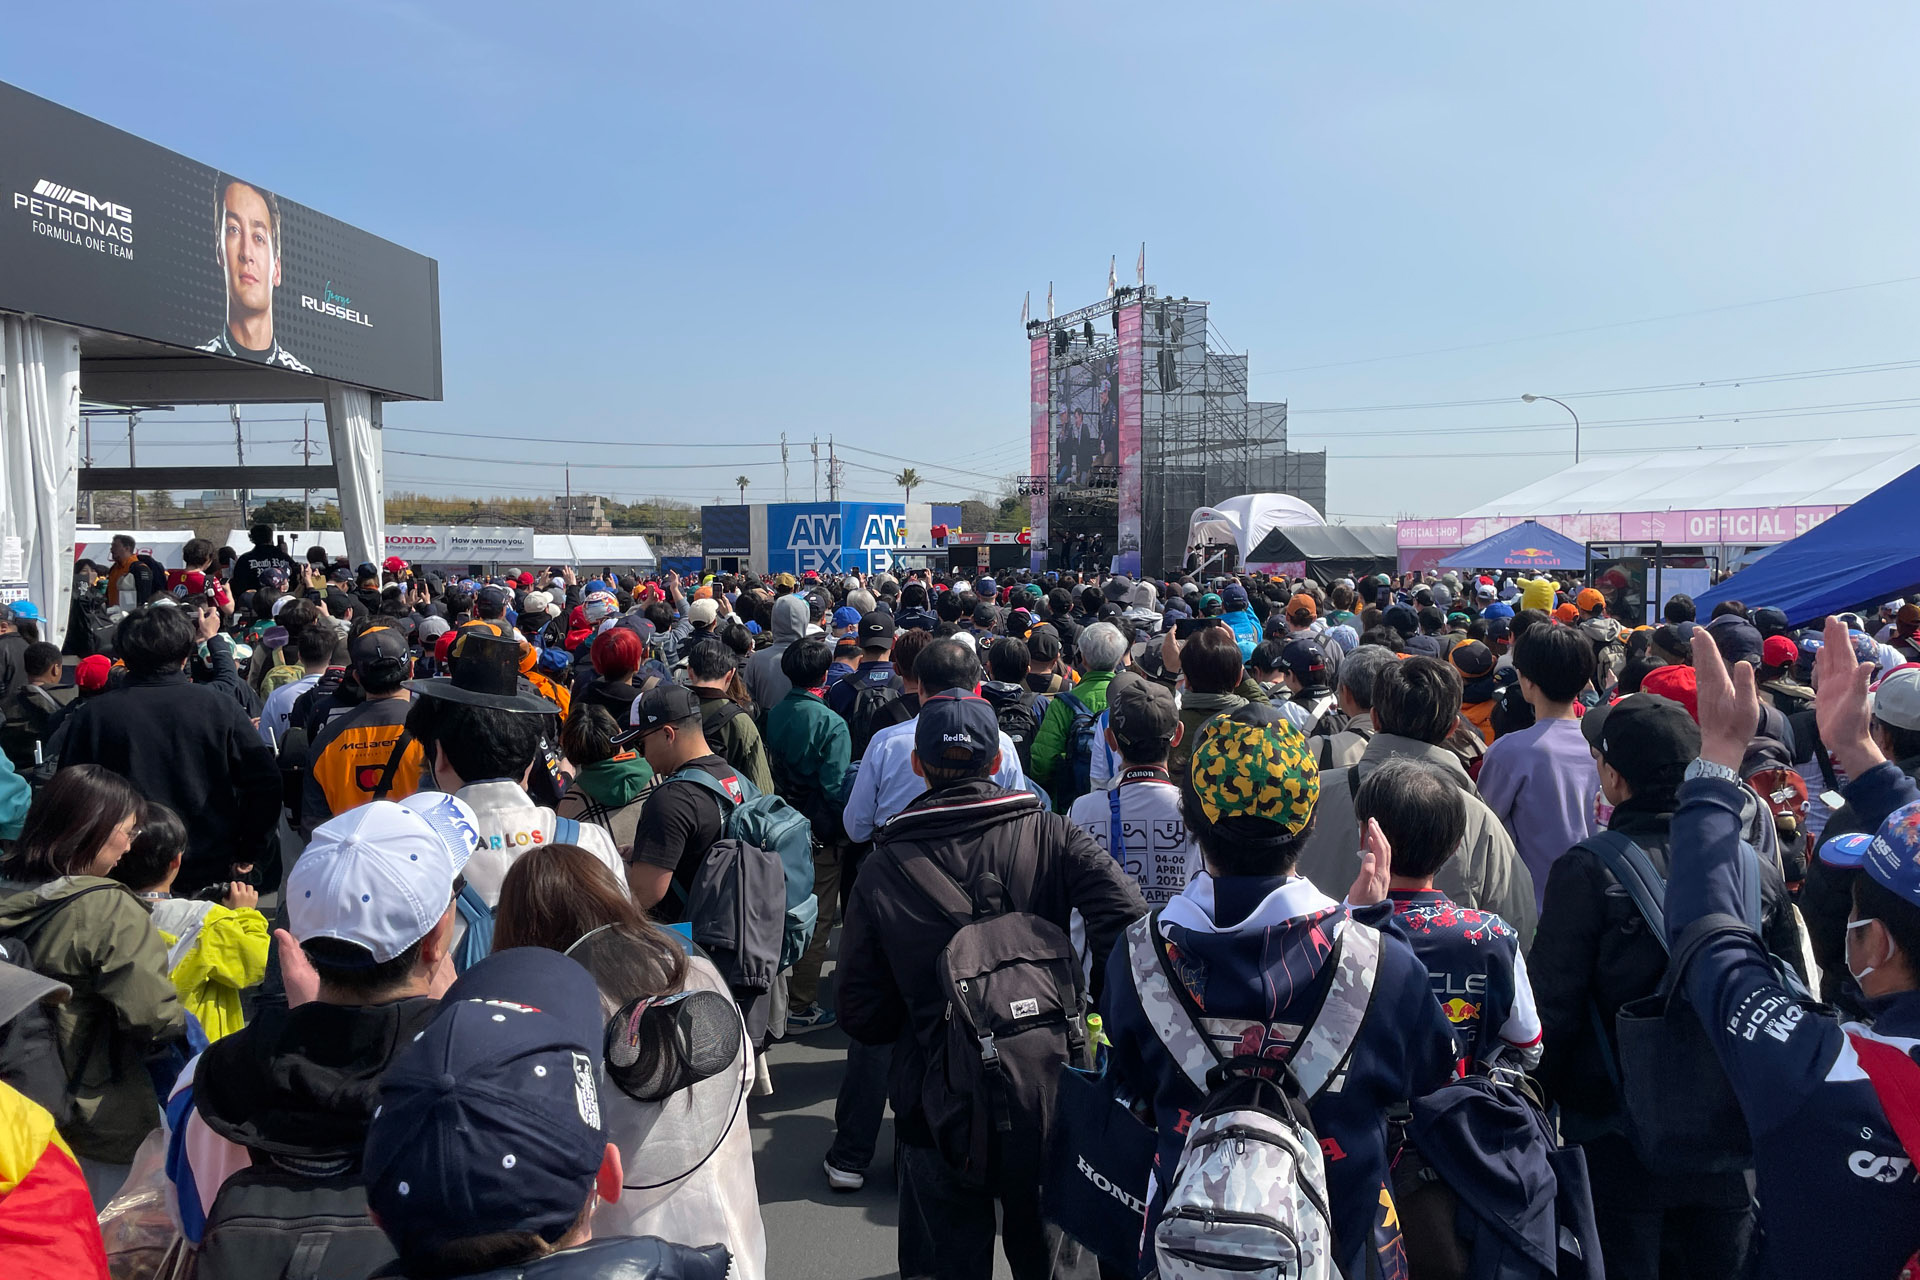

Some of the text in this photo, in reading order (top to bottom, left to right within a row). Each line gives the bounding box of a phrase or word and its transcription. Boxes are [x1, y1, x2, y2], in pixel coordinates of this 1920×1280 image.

[65, 190, 132, 224] AMG
[14, 192, 133, 244] PETRONAS
[33, 220, 134, 261] FORMULA ONE TEAM
[301, 294, 374, 328] RUSSELL
[1690, 514, 1786, 537] OFFICIAL
[1794, 512, 1837, 536] SH
[1401, 526, 1458, 538] OFFICIAL SHOP
[248, 559, 271, 569] Death
[1504, 557, 1560, 566] Red Bull
[176, 585, 187, 598] hp
[943, 734, 958, 742] Red
[1126, 770, 1154, 778] Canon
[1089, 825, 1095, 835] C
[1124, 823, 1131, 832] D
[1167, 823, 1173, 832] E
[1155, 854, 1185, 864] 04-06
[1156, 865, 1186, 875] APRIL
[1137, 875, 1148, 884] M
[1156, 876, 1186, 887] 2025
[1860, 1126, 1873, 1140] S
